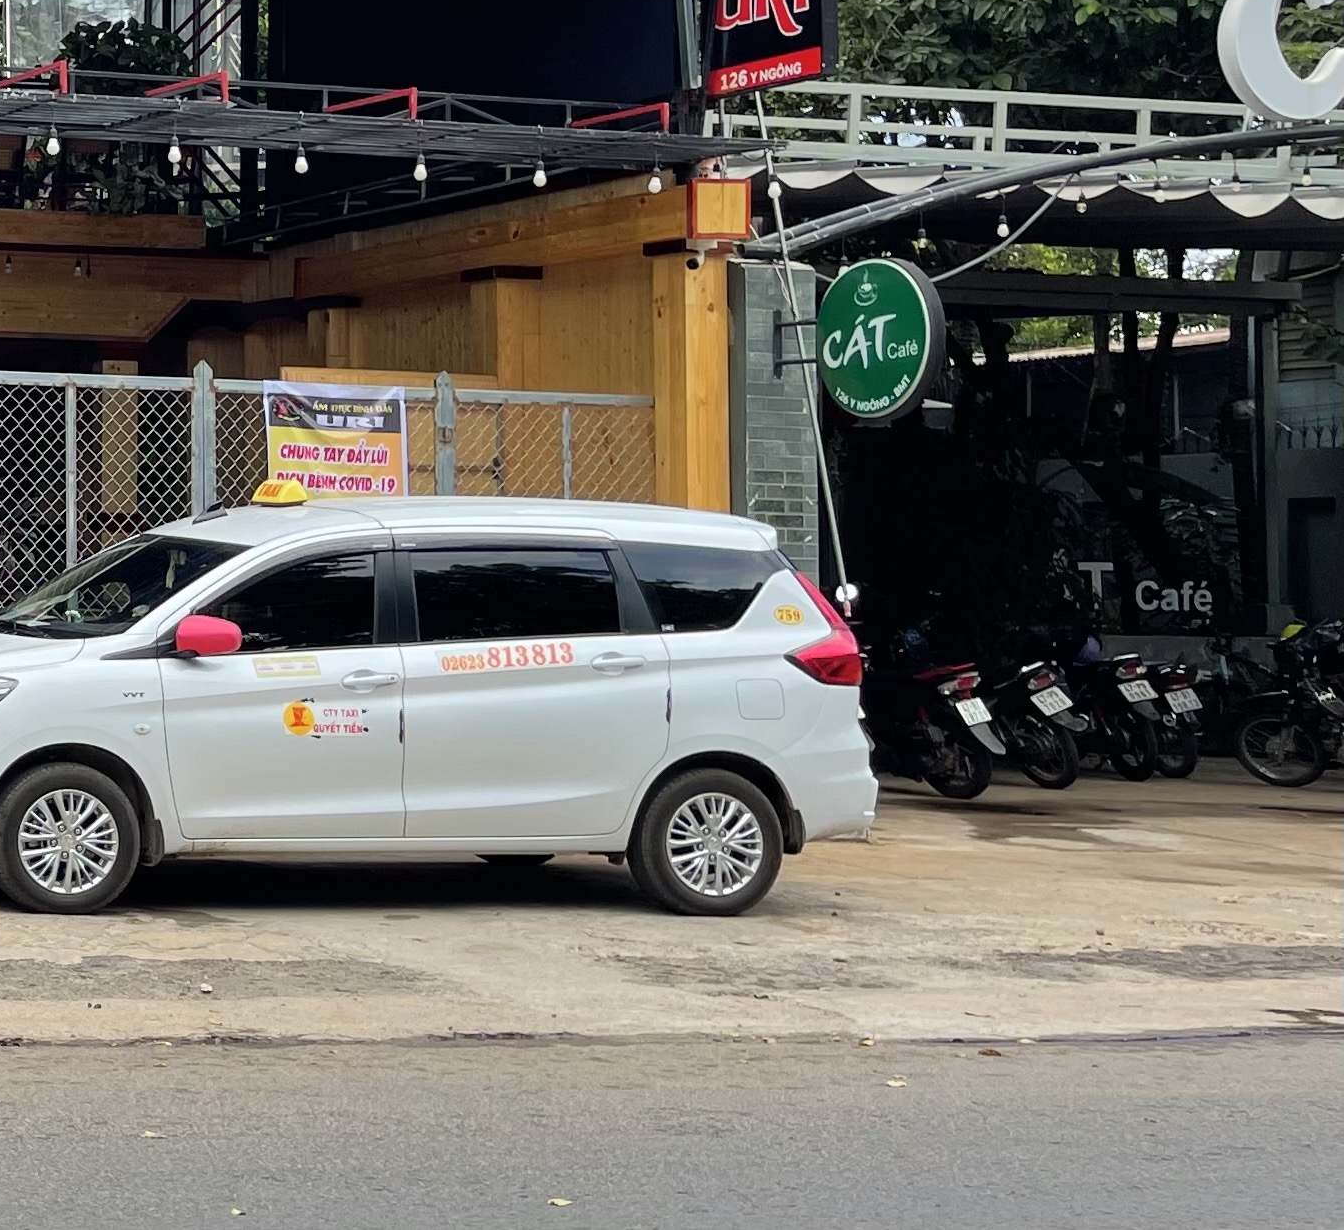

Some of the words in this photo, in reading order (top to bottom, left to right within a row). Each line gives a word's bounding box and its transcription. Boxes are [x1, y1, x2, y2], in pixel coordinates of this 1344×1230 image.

[719, 68, 748, 91] 126
[749, 71, 759, 85] Y
[758, 61, 803, 83] NGÔNG
[822, 313, 897, 369] CÁT
[886, 338, 919, 359] Café
[315, 413, 385, 429] URI
[279, 443, 321, 462] CHUNG
[323, 446, 346, 462] TAY
[258, 483, 283, 497] TAXI
[338, 474, 373, 492] COVID
[1134, 580, 1214, 612] Café
[340, 708, 359, 718] TAXI
